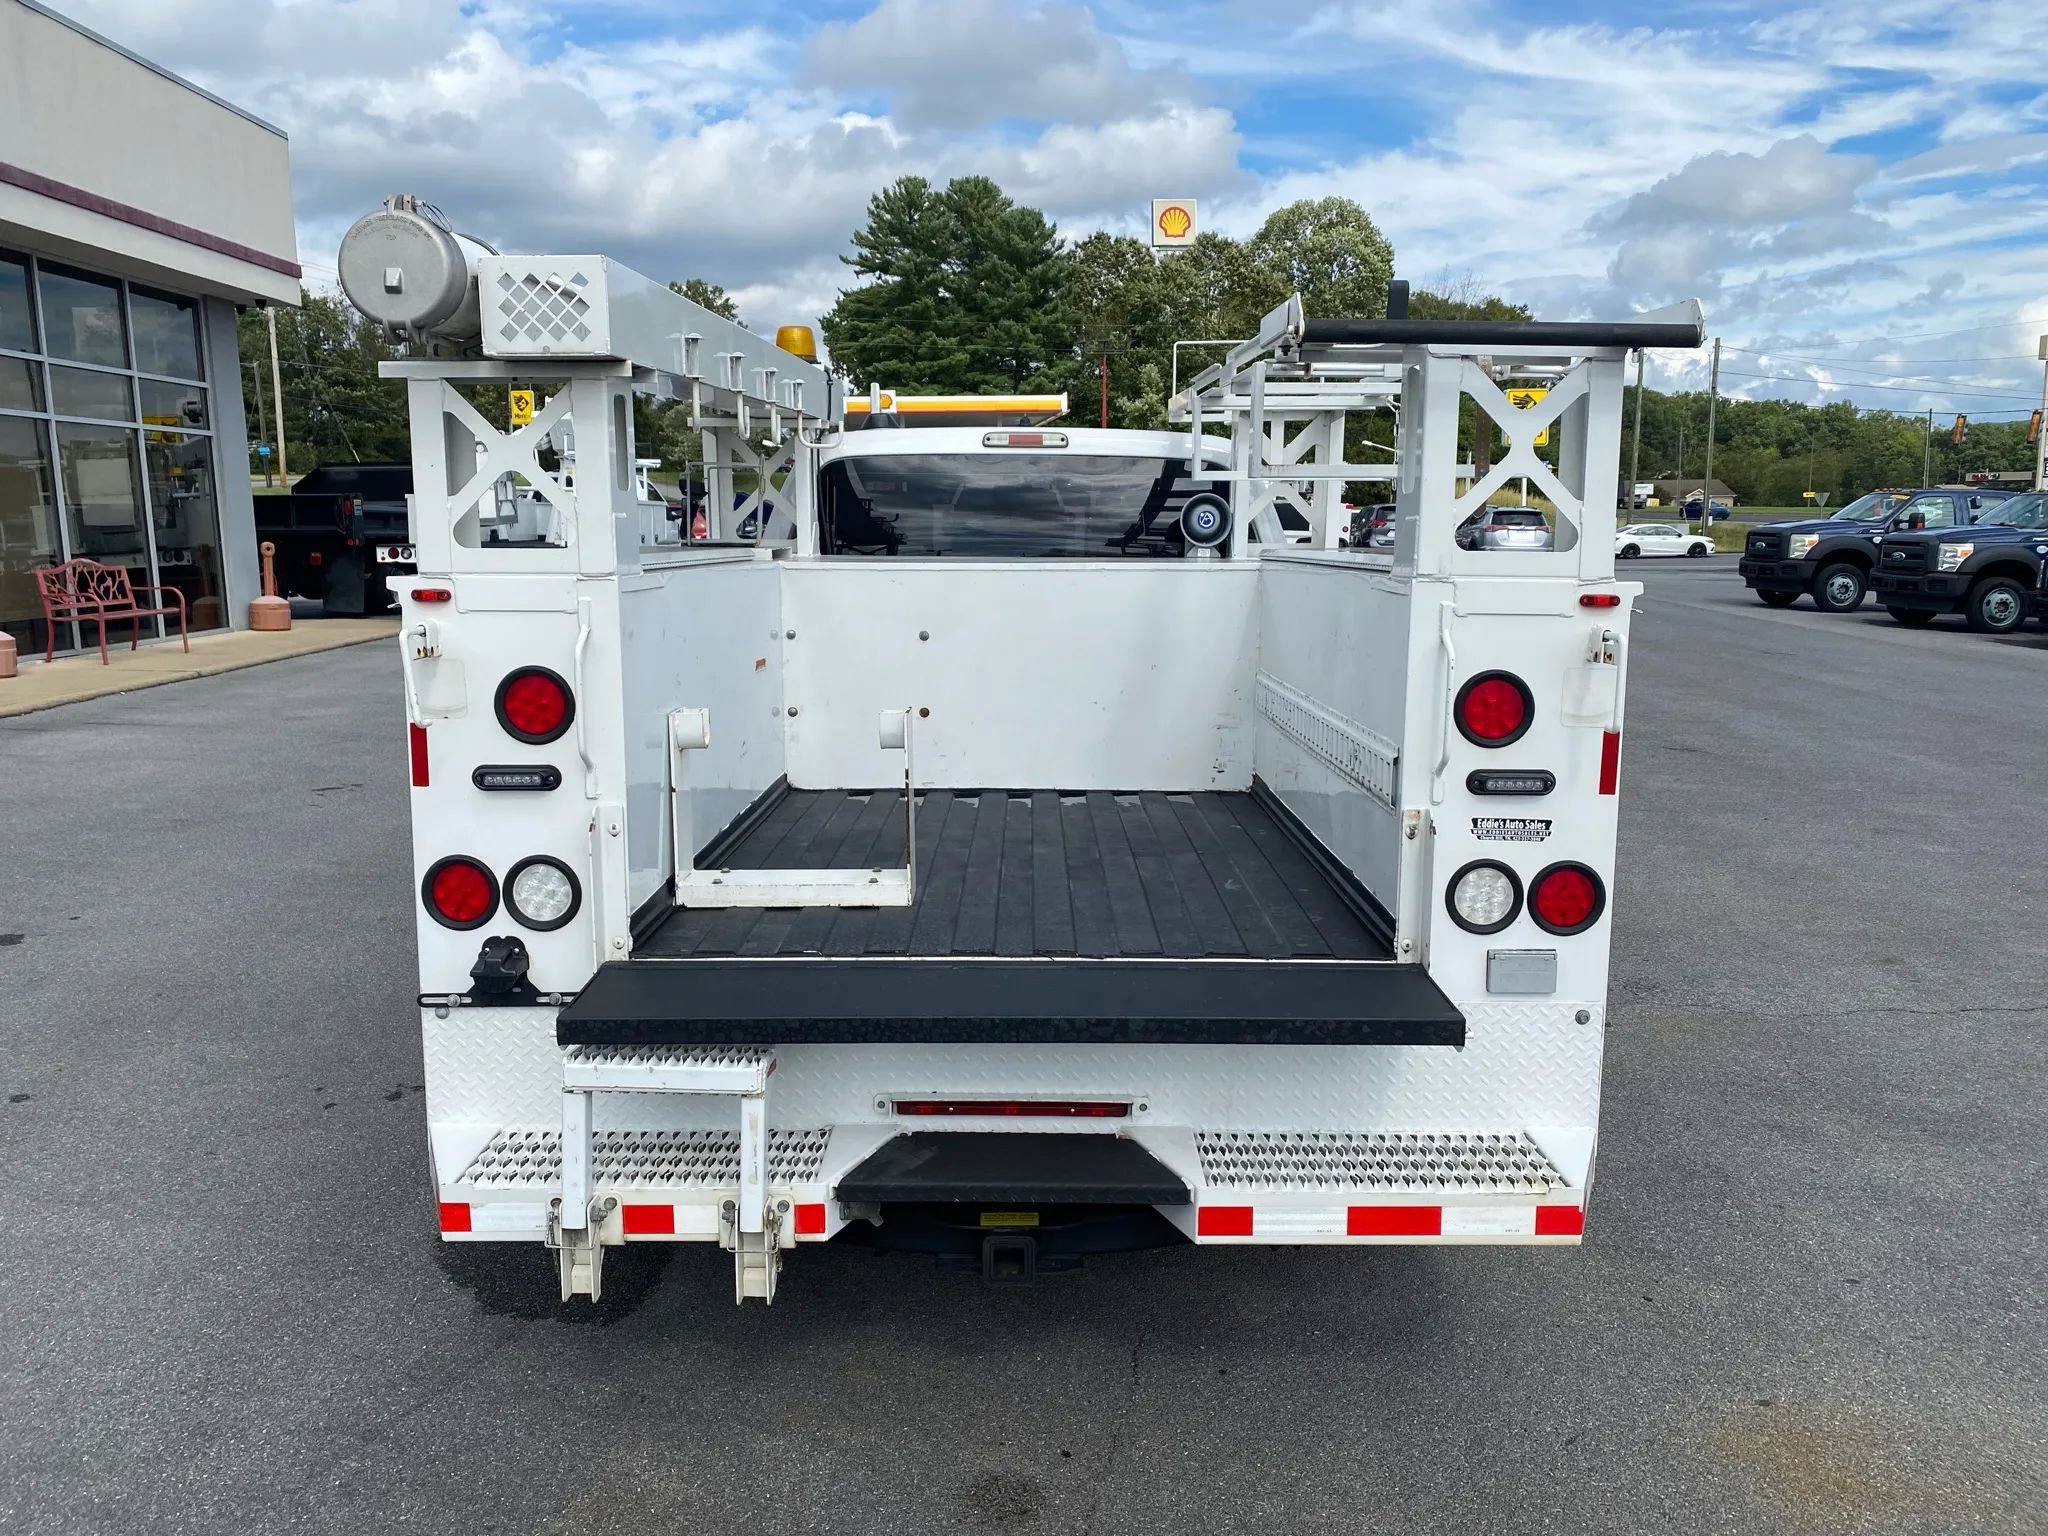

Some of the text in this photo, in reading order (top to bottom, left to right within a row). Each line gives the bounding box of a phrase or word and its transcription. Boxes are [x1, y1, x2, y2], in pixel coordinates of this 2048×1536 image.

[1477, 818, 1546, 830] Eddie's Auto Sales
